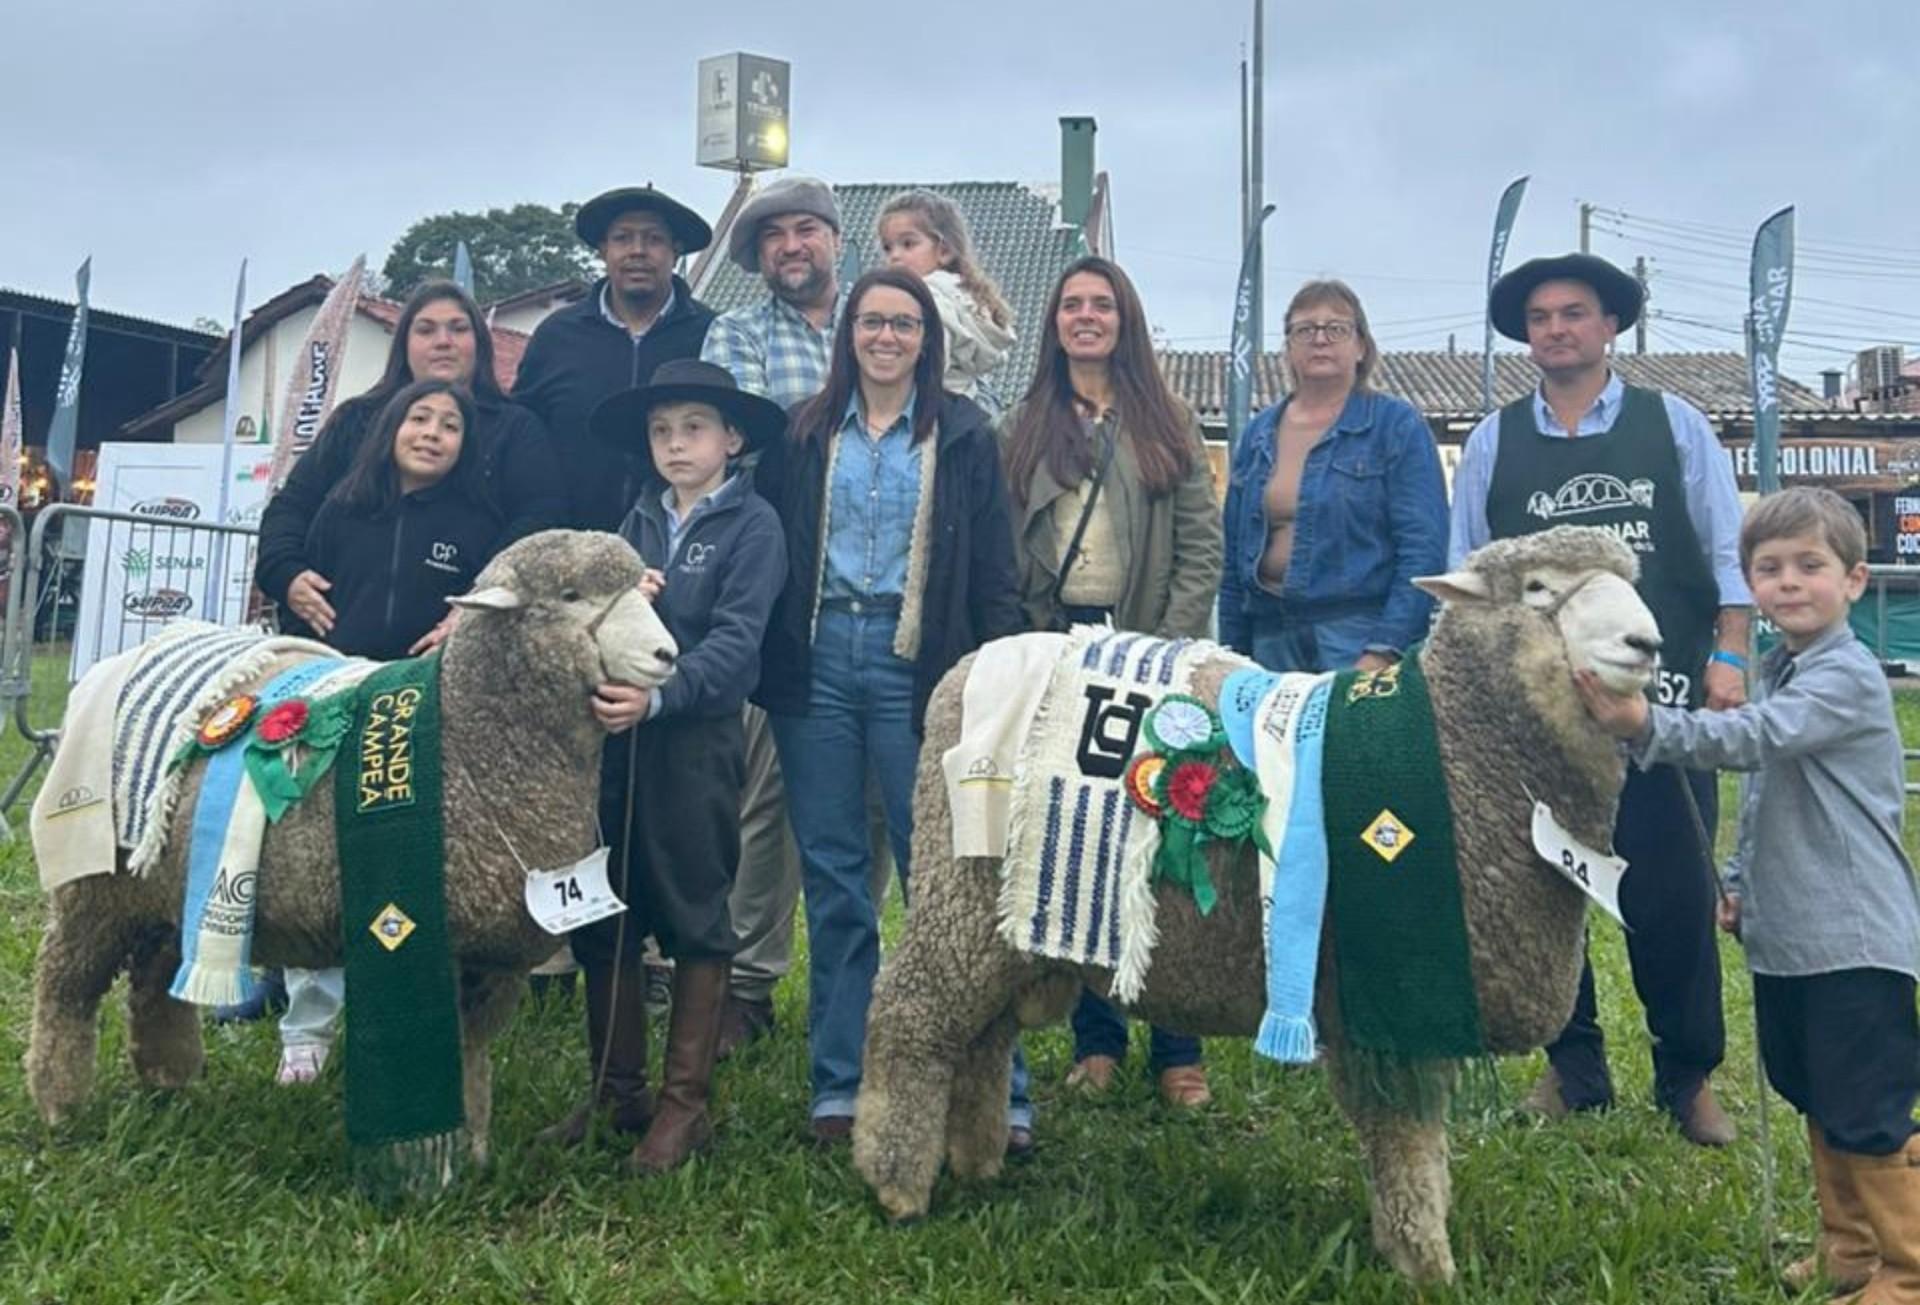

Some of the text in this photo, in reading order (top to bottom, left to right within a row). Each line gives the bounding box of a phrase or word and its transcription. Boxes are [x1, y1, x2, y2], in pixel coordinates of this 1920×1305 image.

[1601, 520, 1651, 541] NAR
[155, 556, 205, 571] SENAR
[387, 688, 422, 801] GRANDE
[553, 876, 584, 908] 74
